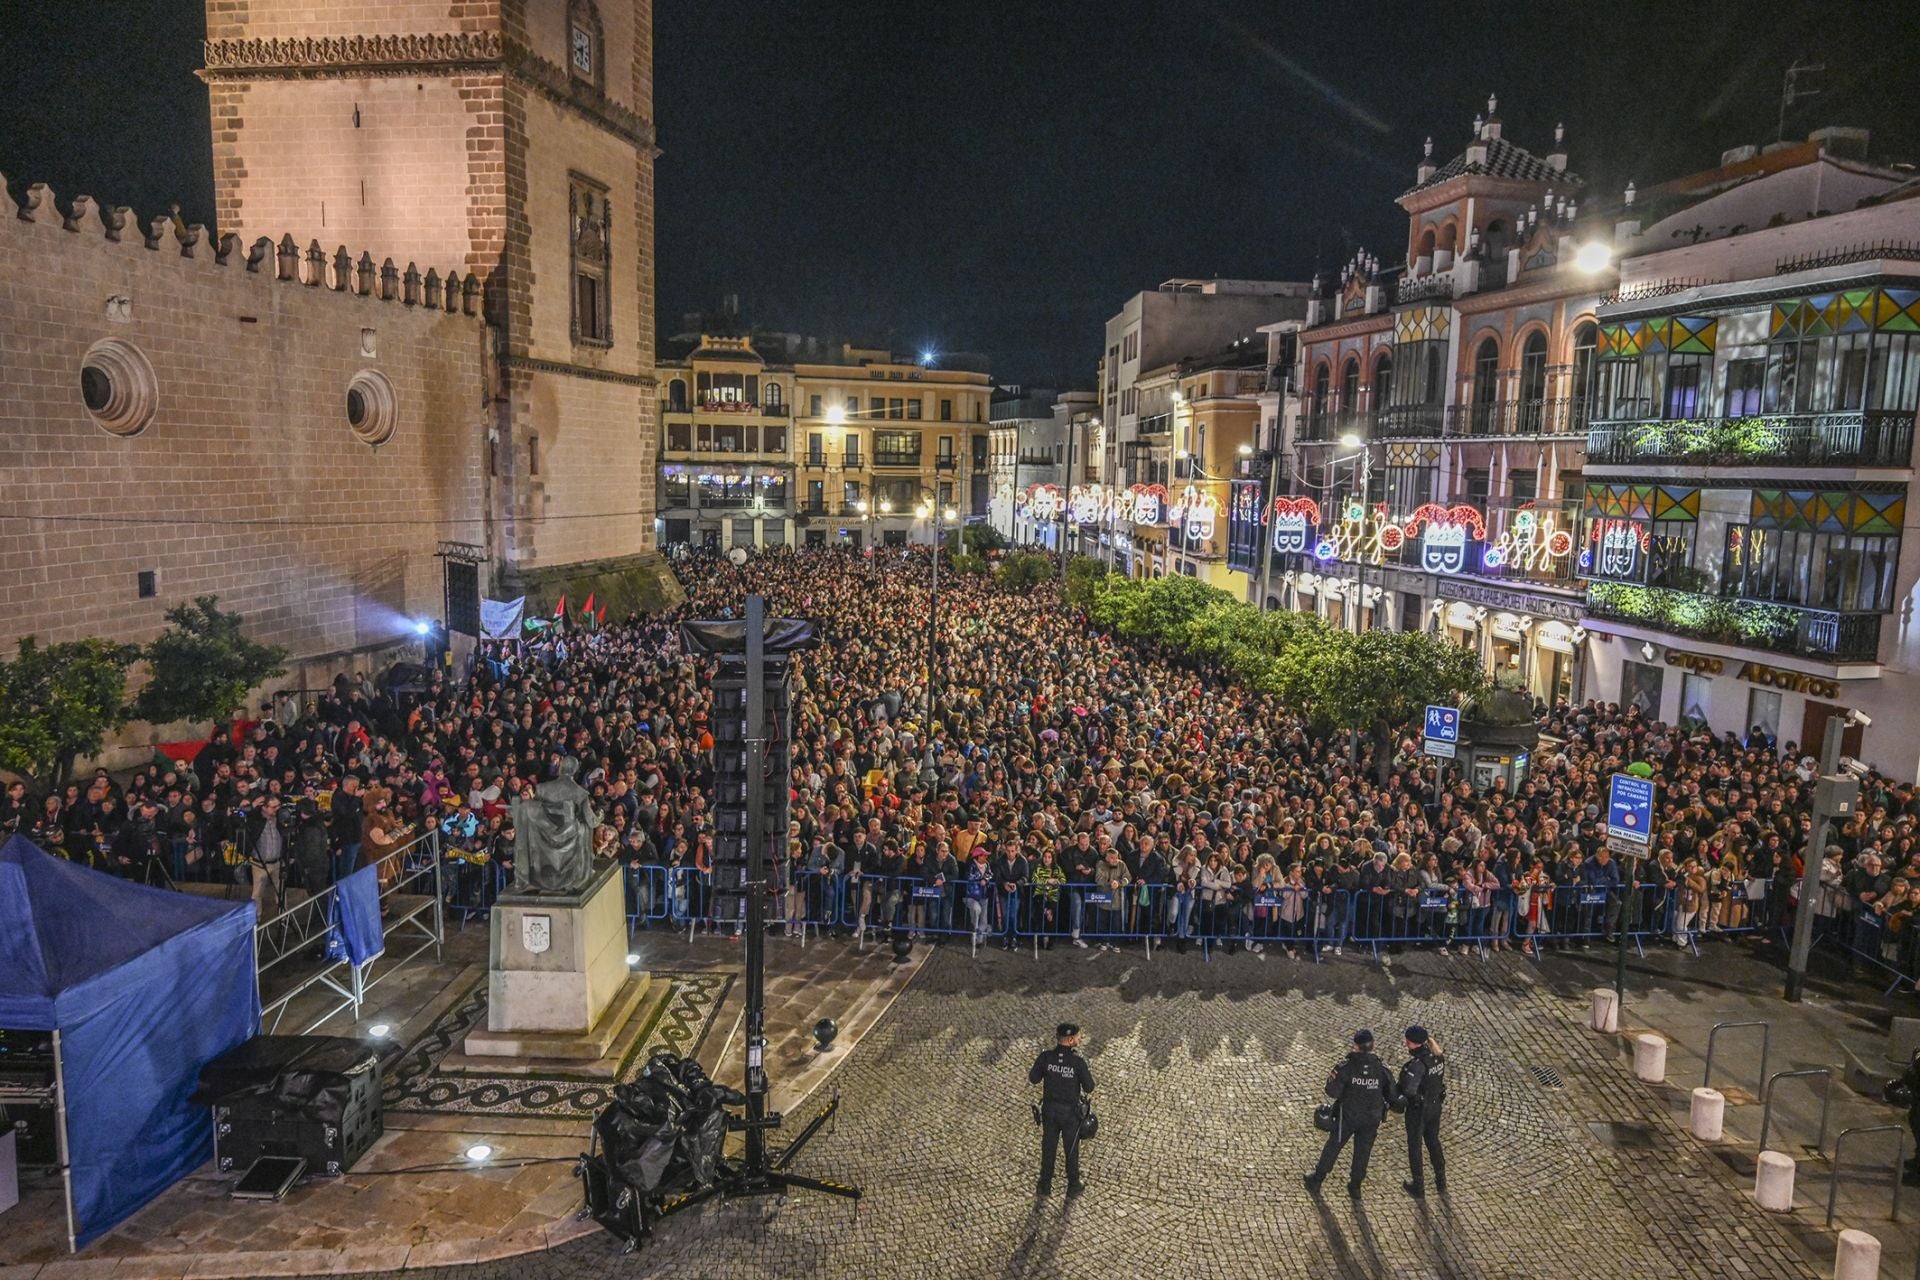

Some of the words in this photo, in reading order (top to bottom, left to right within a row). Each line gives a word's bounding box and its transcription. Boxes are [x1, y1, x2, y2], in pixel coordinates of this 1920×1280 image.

[1664, 648, 1723, 676] Grupo
[1048, 1064, 1074, 1075] POLICIA
[1352, 1077, 1379, 1086] POLICIA
